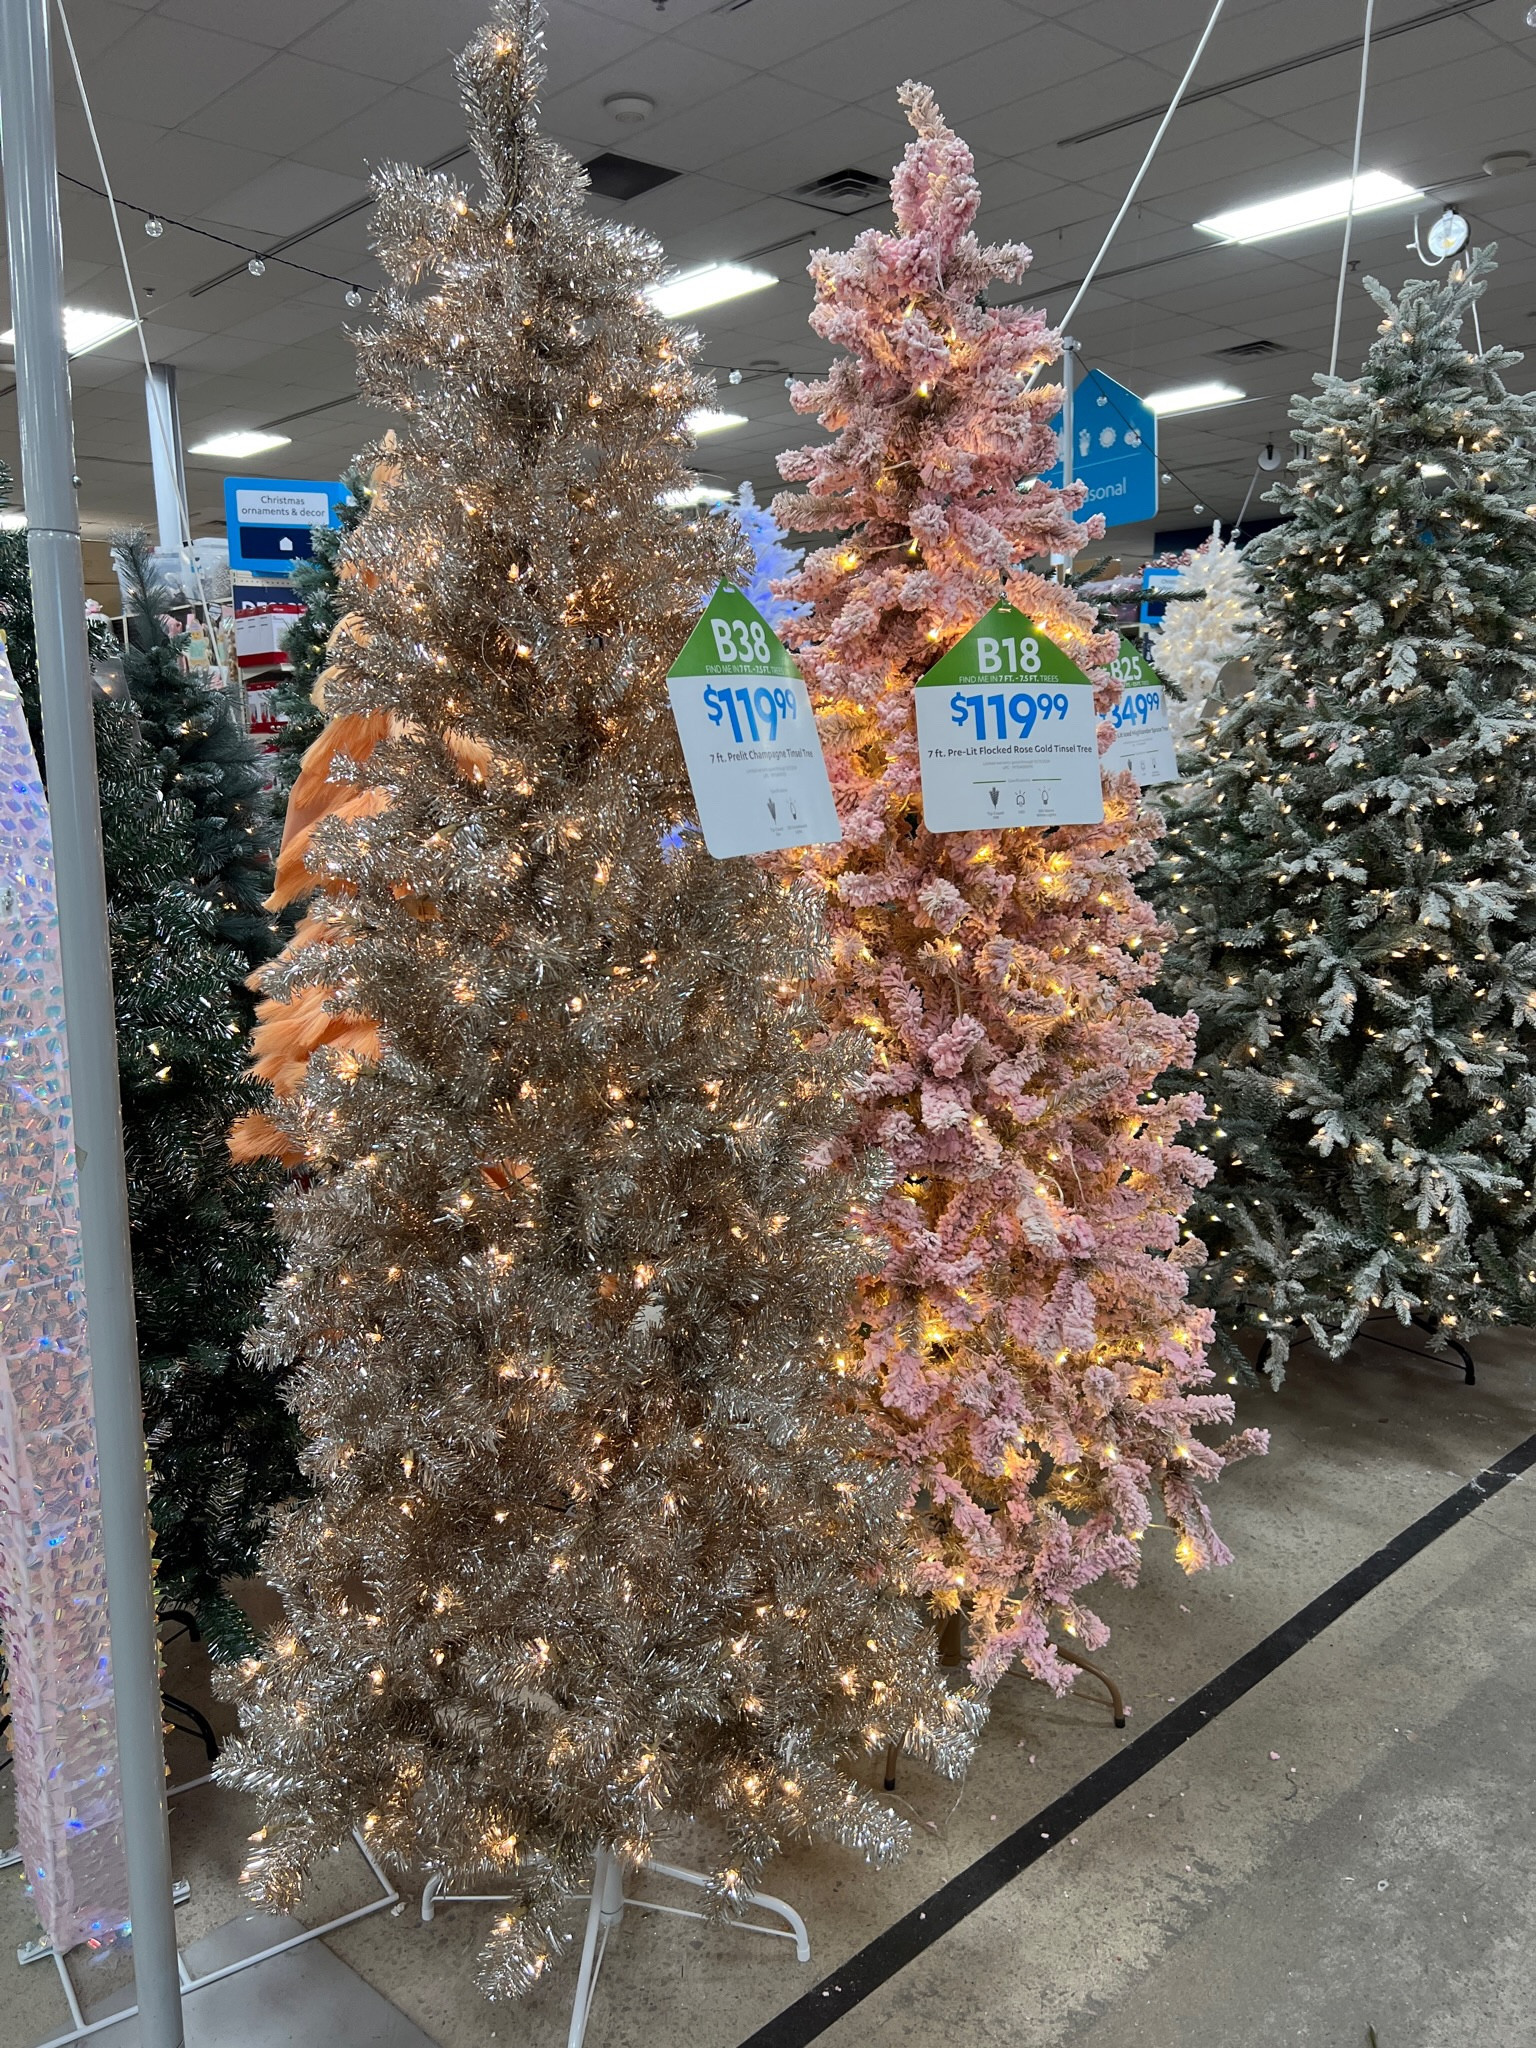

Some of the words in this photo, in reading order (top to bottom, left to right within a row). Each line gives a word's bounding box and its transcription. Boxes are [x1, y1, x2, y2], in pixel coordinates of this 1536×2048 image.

[1082, 476, 1127, 503] asonal
[260, 495, 305, 505] Christmas
[241, 507, 290, 516] ornaments
[291, 508, 298, 516] &
[299, 507, 326, 517] decor
[710, 618, 771, 664] B38
[976, 636, 1042, 674] B18
[722, 664, 732, 674] ME
[1110, 655, 1142, 681] B25
[959, 675, 977, 684] FIND
[980, 675, 990, 683] ME
[990, 675, 998, 683] IN
[1029, 674, 1039, 682] FT.
[1040, 674, 1059, 682] TREES
[709, 754, 715, 764] 7
[716, 752, 727, 763] ft.
[727, 750, 748, 761] Prelit
[748, 749, 786, 761] Champagne
[785, 747, 802, 758] Tinsel
[802, 748, 814, 758] Tree
[927, 750, 933, 759] 7
[934, 748, 947, 758] ft.
[947, 747, 978, 757] Pre-Lit
[979, 745, 1012, 755] Flocked
[1013, 745, 1034, 754] Rose
[1034, 744, 1053, 754] Gold
[1053, 744, 1076, 753] Tinsel
[1076, 745, 1093, 753] Tree
